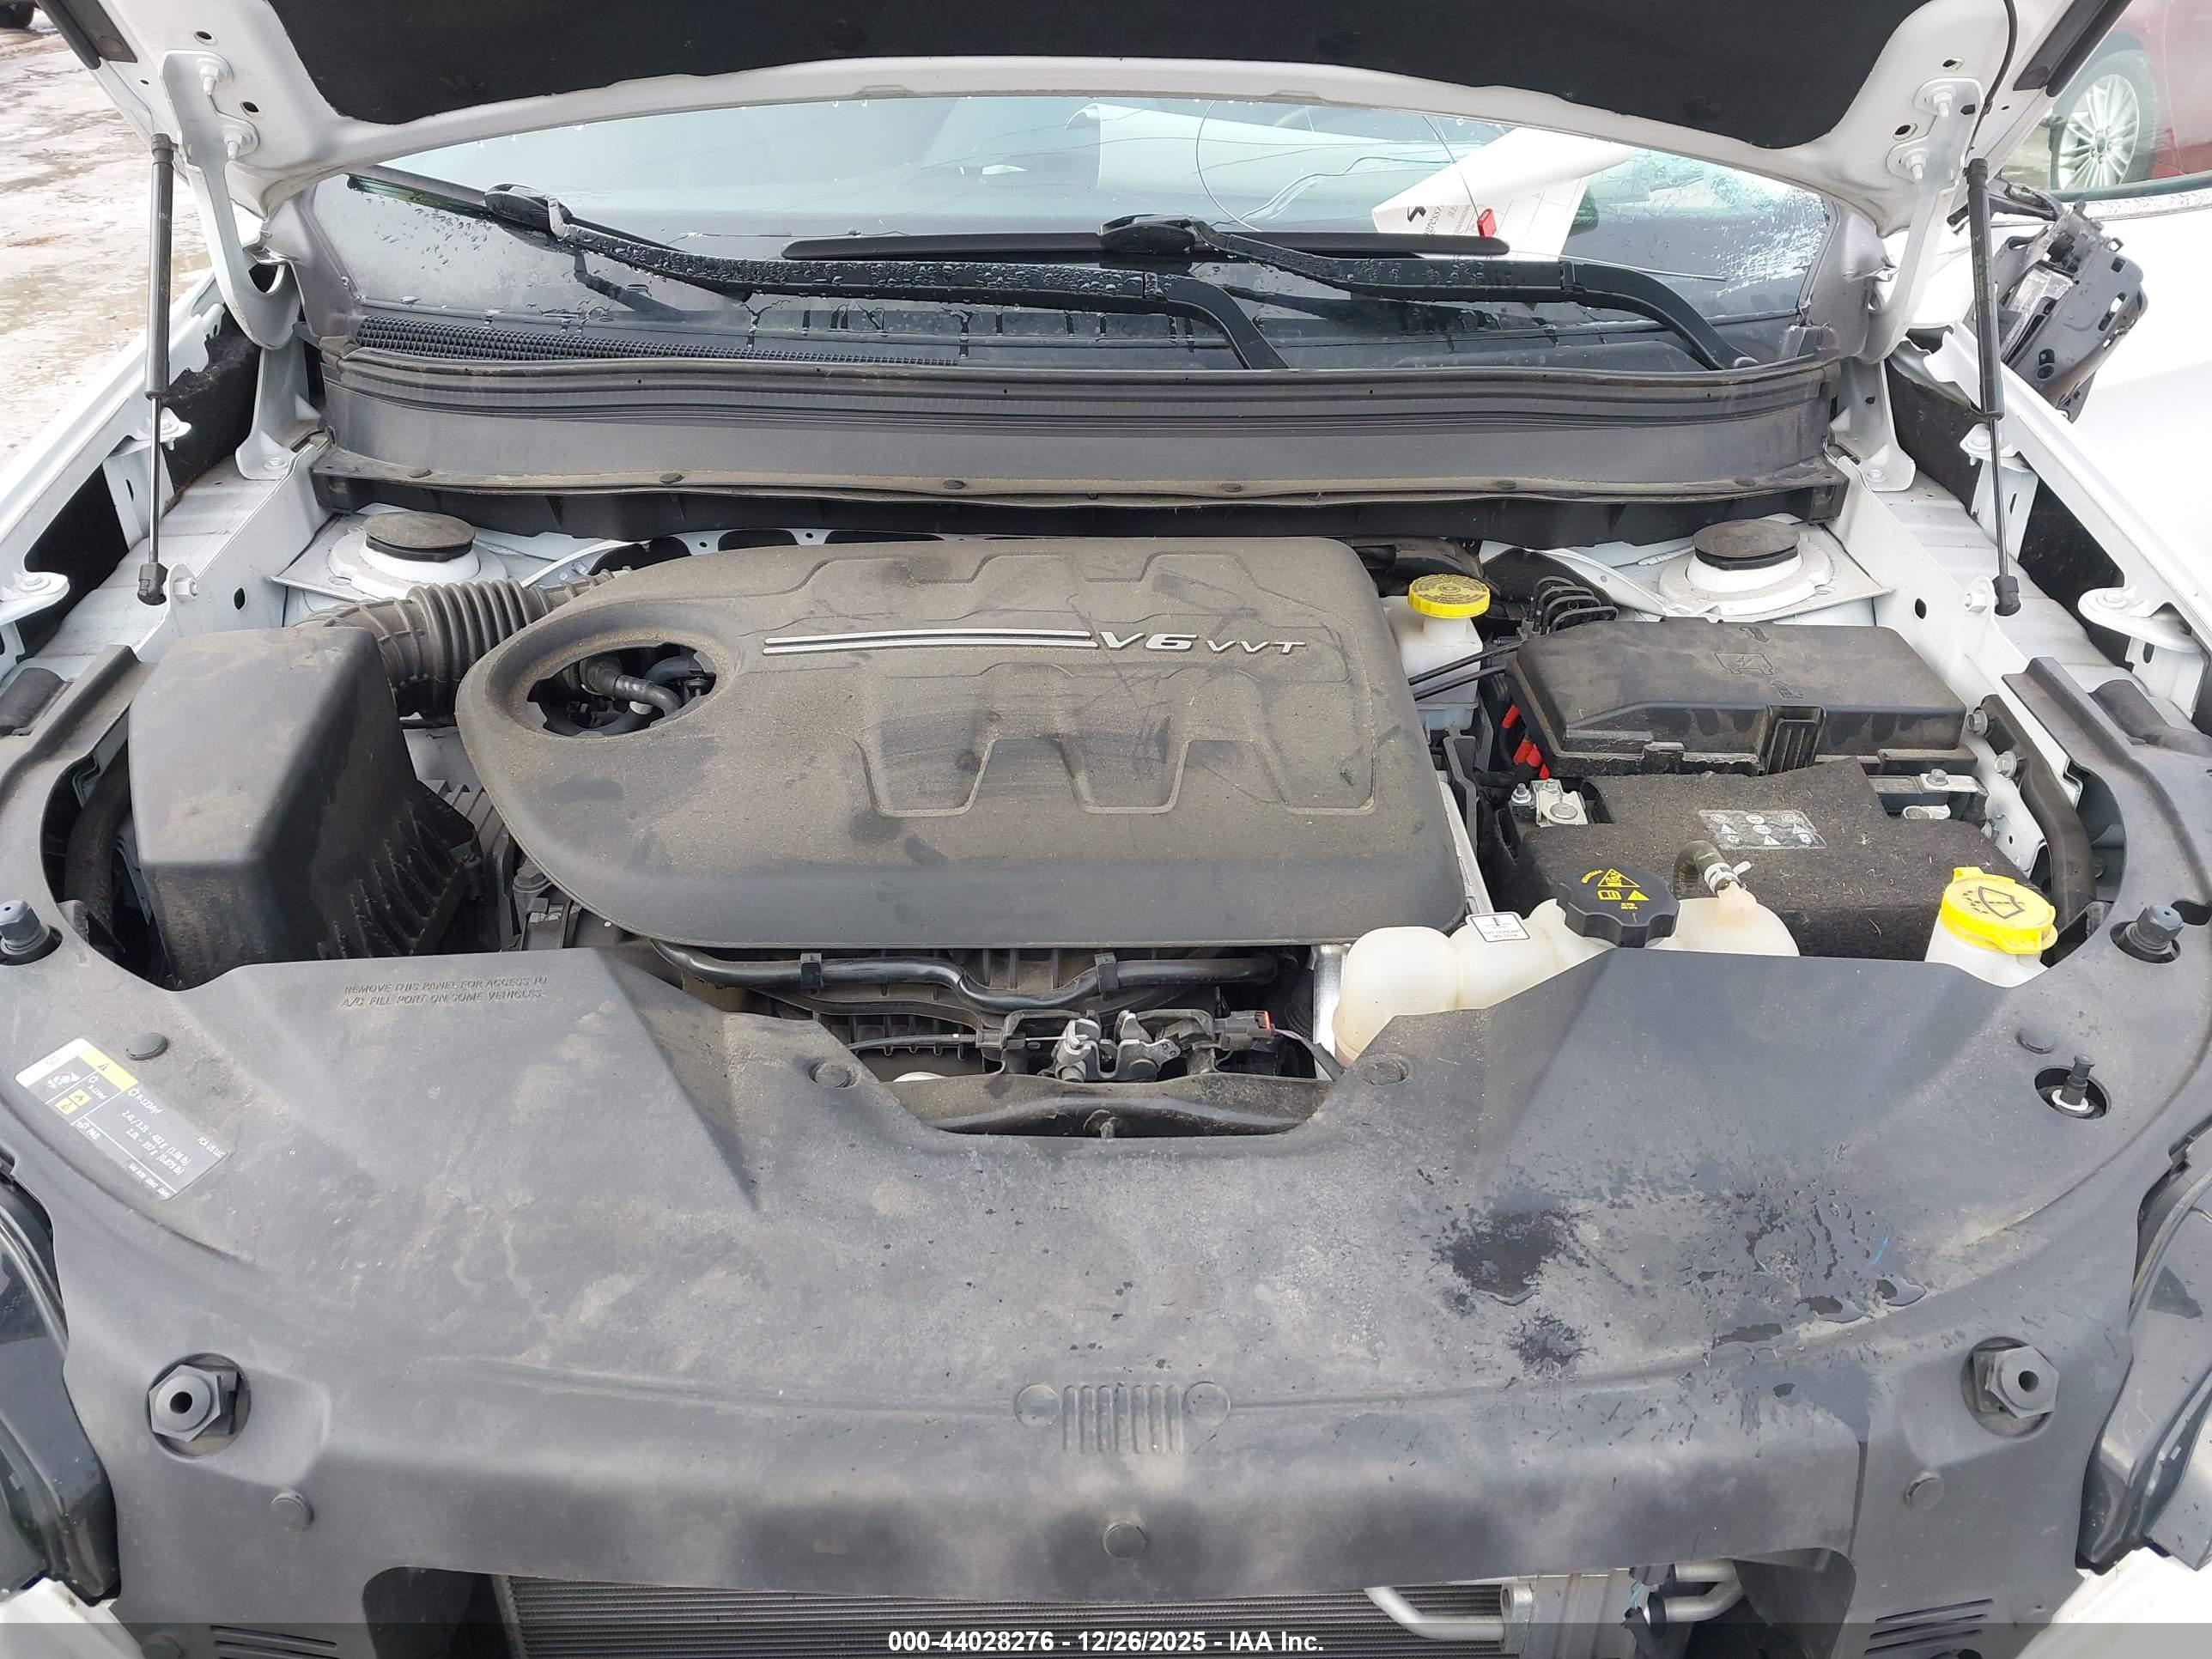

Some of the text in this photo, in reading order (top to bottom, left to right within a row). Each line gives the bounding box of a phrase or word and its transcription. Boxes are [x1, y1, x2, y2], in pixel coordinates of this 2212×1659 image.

[1100, 631, 1306, 654] V6 VVT
[344, 976, 547, 994] REMOVE THIS PANEL FOR ACCESS TO
[341, 989, 544, 1007] A/C FILL PORT ON SOME VEHICLES
[137, 1094, 163, 1115] R-1234yf
[196, 1136, 208, 1147] FCA
